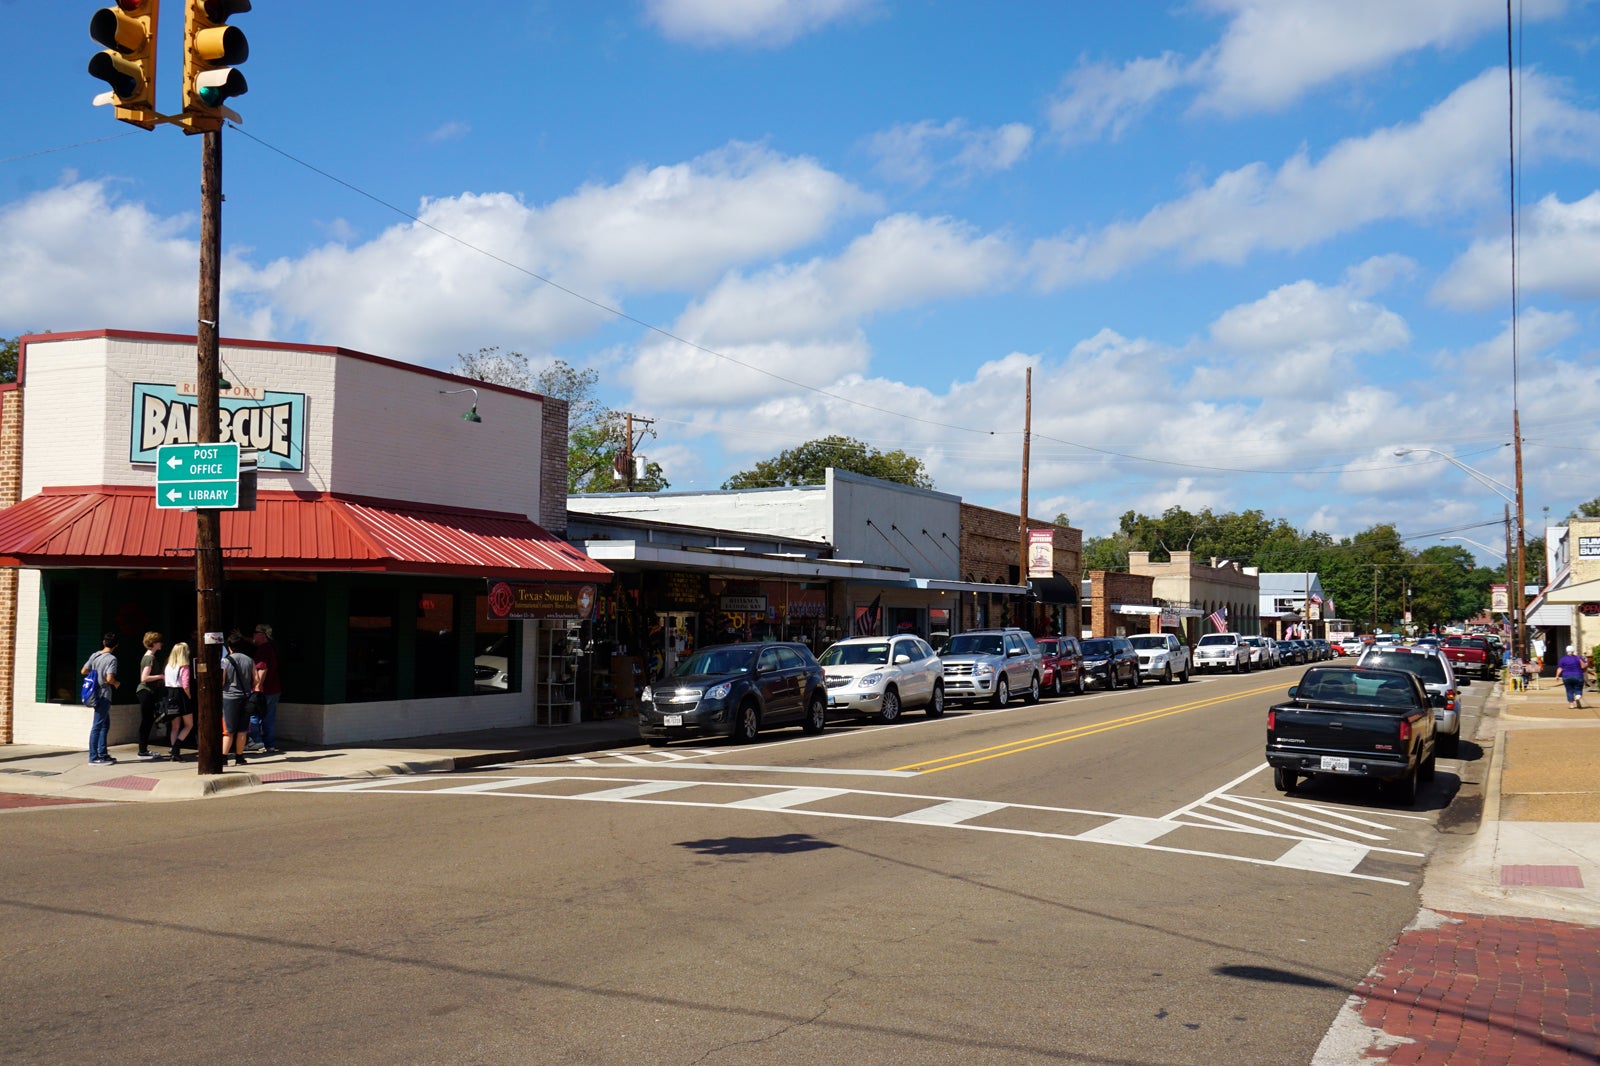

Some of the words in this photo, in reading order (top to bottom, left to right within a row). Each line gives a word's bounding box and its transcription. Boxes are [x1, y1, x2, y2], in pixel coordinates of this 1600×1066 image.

[183, 383, 257, 397] RIPORT
[194, 449, 218, 460] POST
[190, 464, 223, 475] OFFICE
[188, 490, 229, 501] LIBRARY
[518, 588, 543, 601] Texas
[544, 590, 573, 601] Sounds
